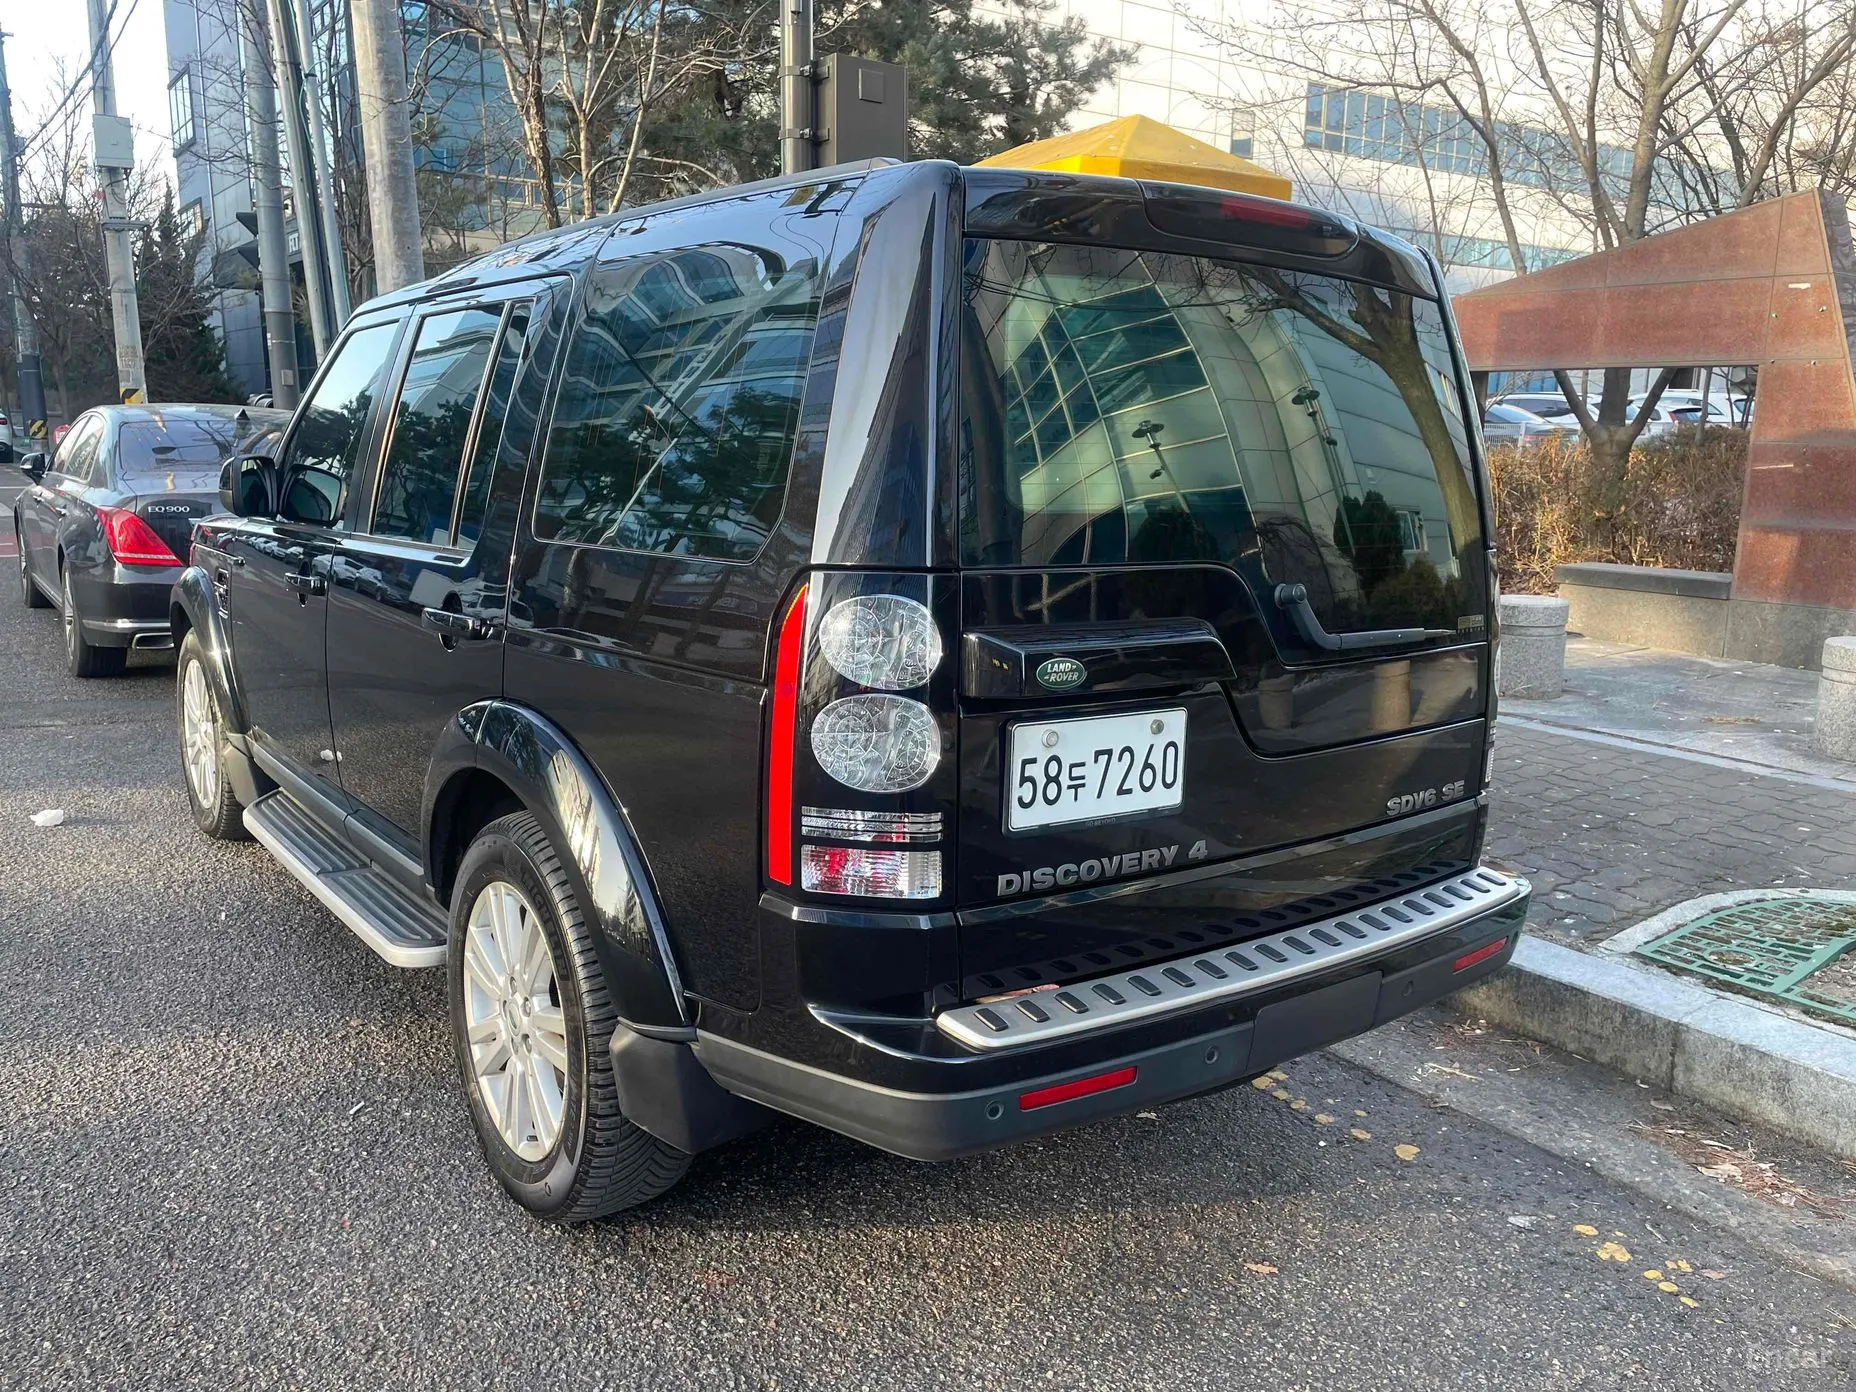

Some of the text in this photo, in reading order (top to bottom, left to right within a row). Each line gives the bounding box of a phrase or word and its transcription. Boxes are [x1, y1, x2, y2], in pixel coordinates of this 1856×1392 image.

[1047, 662, 1072, 673] LAND
[1049, 672, 1079, 682] ROVER
[1017, 741, 1179, 809] 58두7260
[1386, 780, 1465, 816] SDV6 SE
[997, 839, 1209, 897] DISCOVERY 4
